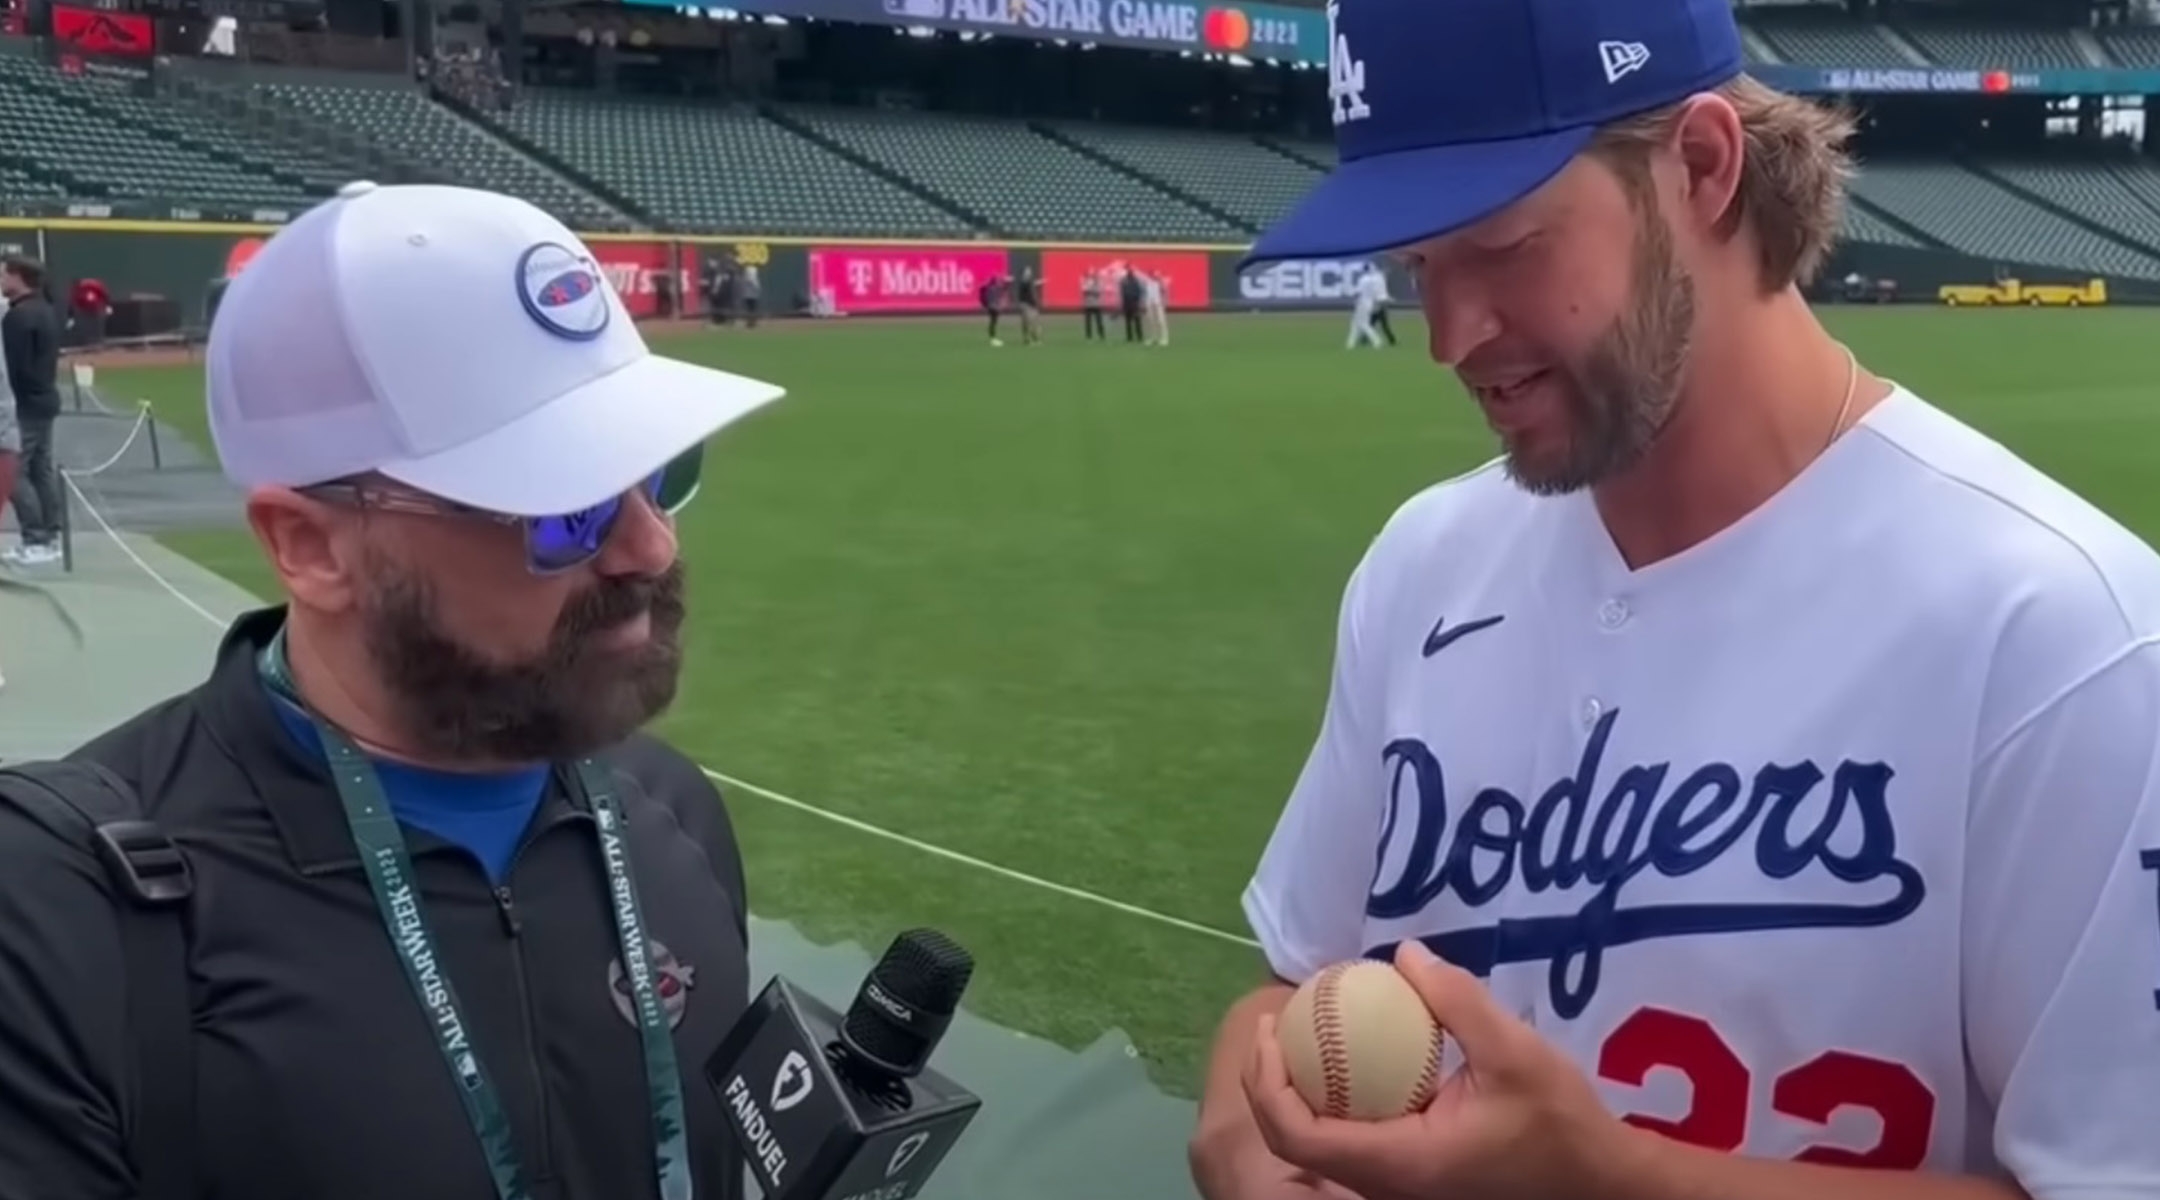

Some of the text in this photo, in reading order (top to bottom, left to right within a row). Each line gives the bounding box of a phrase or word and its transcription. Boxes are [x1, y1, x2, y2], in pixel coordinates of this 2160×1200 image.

[1109, 5, 1198, 42] GAME
[1252, 17, 1299, 45] 2023
[1931, 70, 1981, 92] GAME
[847, 259, 974, 296] T Mobile
[1365, 708, 1926, 1020] Dodgers
[387, 883, 428, 958] WEEK
[623, 926, 651, 992] WEEK
[725, 1075, 788, 1188] FANDUEL
